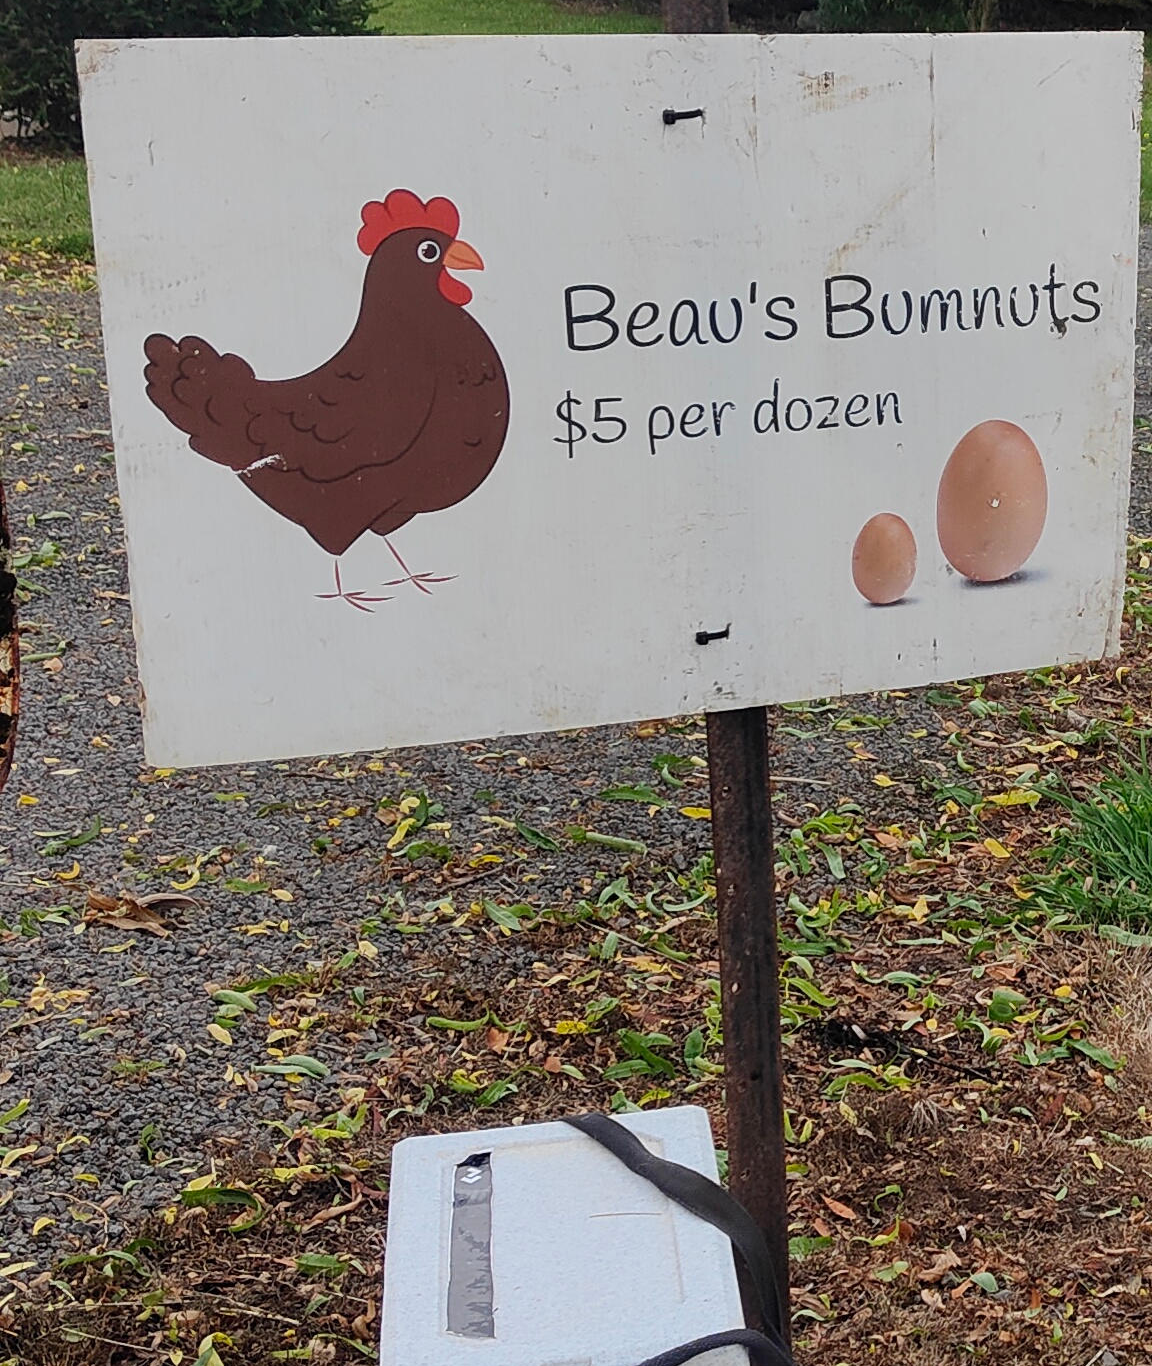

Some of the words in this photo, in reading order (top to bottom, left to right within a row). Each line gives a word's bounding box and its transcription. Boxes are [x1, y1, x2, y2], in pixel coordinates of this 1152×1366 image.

[564, 281, 799, 352] Beau's
[825, 263, 1102, 337] Bumnuts
[553, 389, 627, 459] $5
[648, 398, 736, 456] per
[753, 378, 903, 434] dozen
